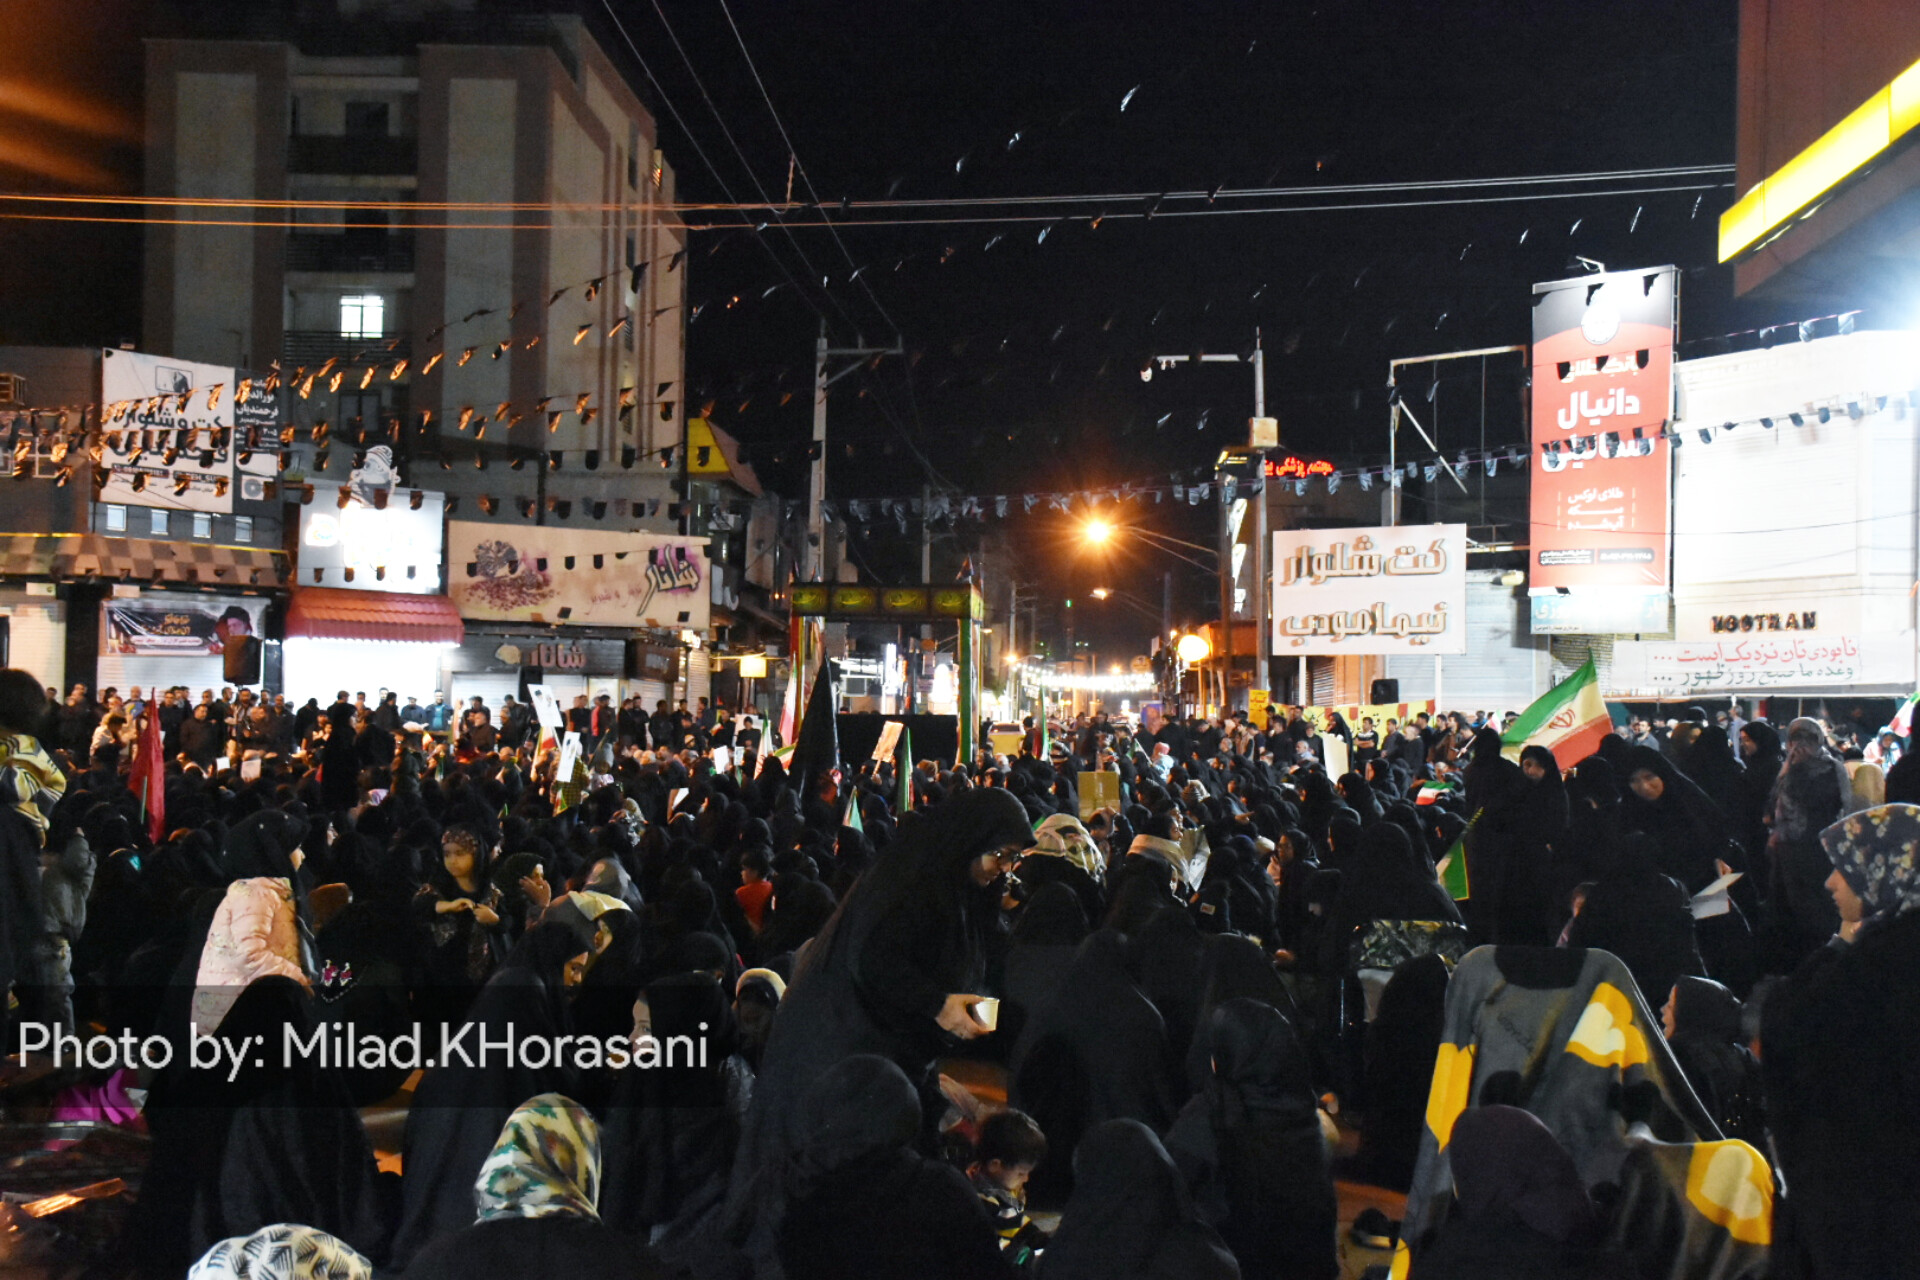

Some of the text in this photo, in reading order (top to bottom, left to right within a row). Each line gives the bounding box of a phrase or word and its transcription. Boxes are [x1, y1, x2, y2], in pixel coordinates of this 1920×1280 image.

[1557, 387, 1640, 430] دانیال
[1281, 535, 1449, 586] کت شلوار
[1281, 601, 1448, 648] نیما مودب
[1677, 642, 1723, 662] است
[1724, 641, 1784, 669] نزدیک
[1780, 639, 1807, 663] تان
[1808, 636, 1857, 664] نابودی
[1680, 662, 1725, 686] ظهور
[1799, 663, 1813, 677] ما
